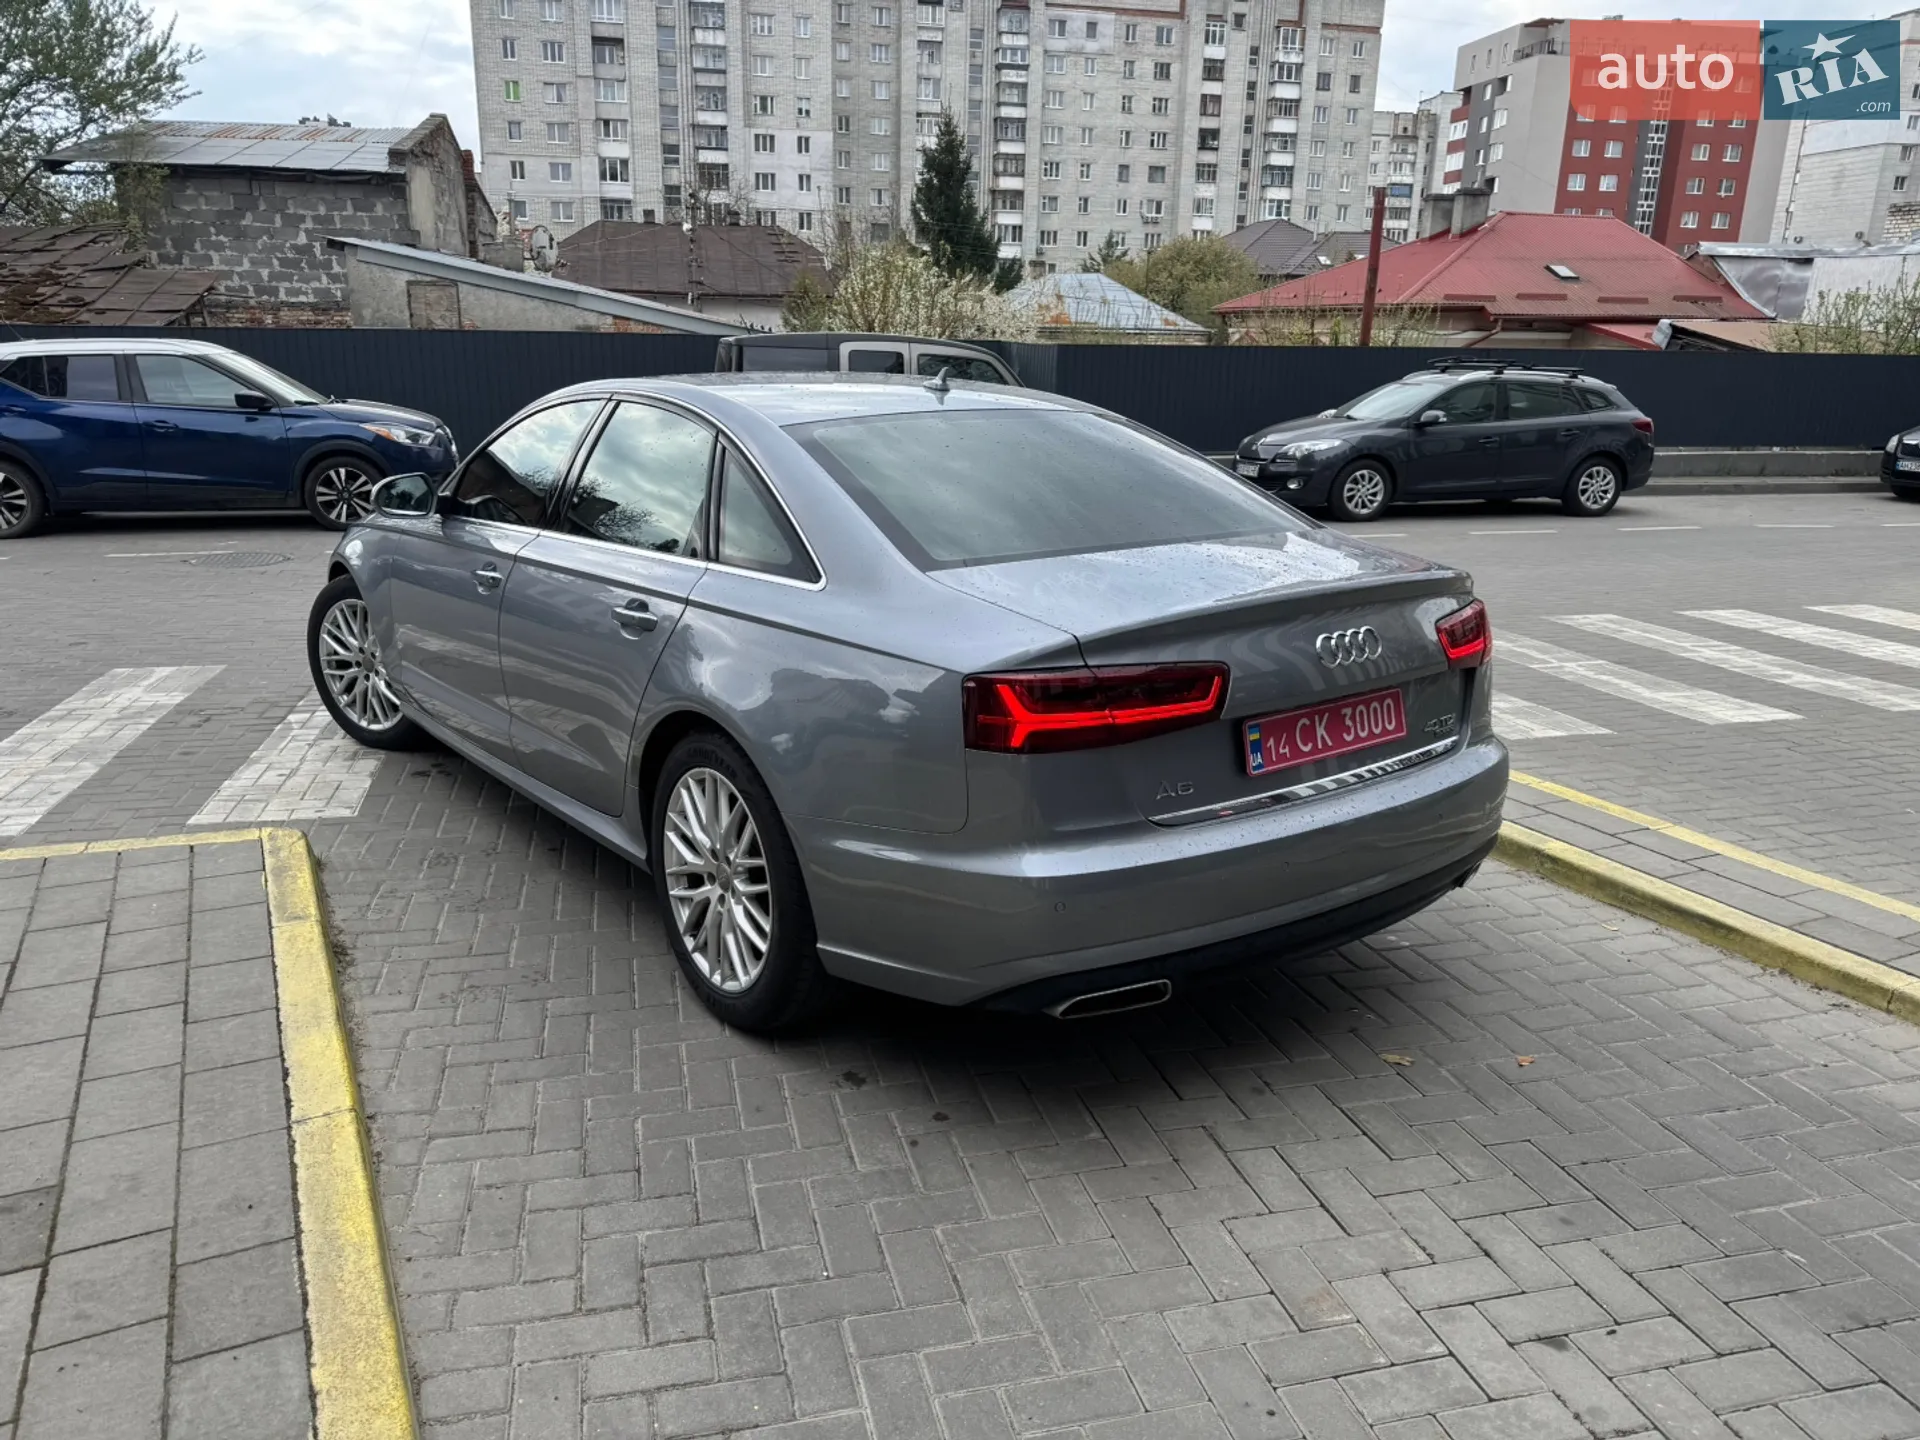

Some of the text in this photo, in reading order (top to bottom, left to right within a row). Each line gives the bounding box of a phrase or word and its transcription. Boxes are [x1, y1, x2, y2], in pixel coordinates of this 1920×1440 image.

[1267, 698, 1396, 762] 14 CK 3000
[1250, 751, 1263, 767] UA
[1155, 780, 1194, 800] A6
